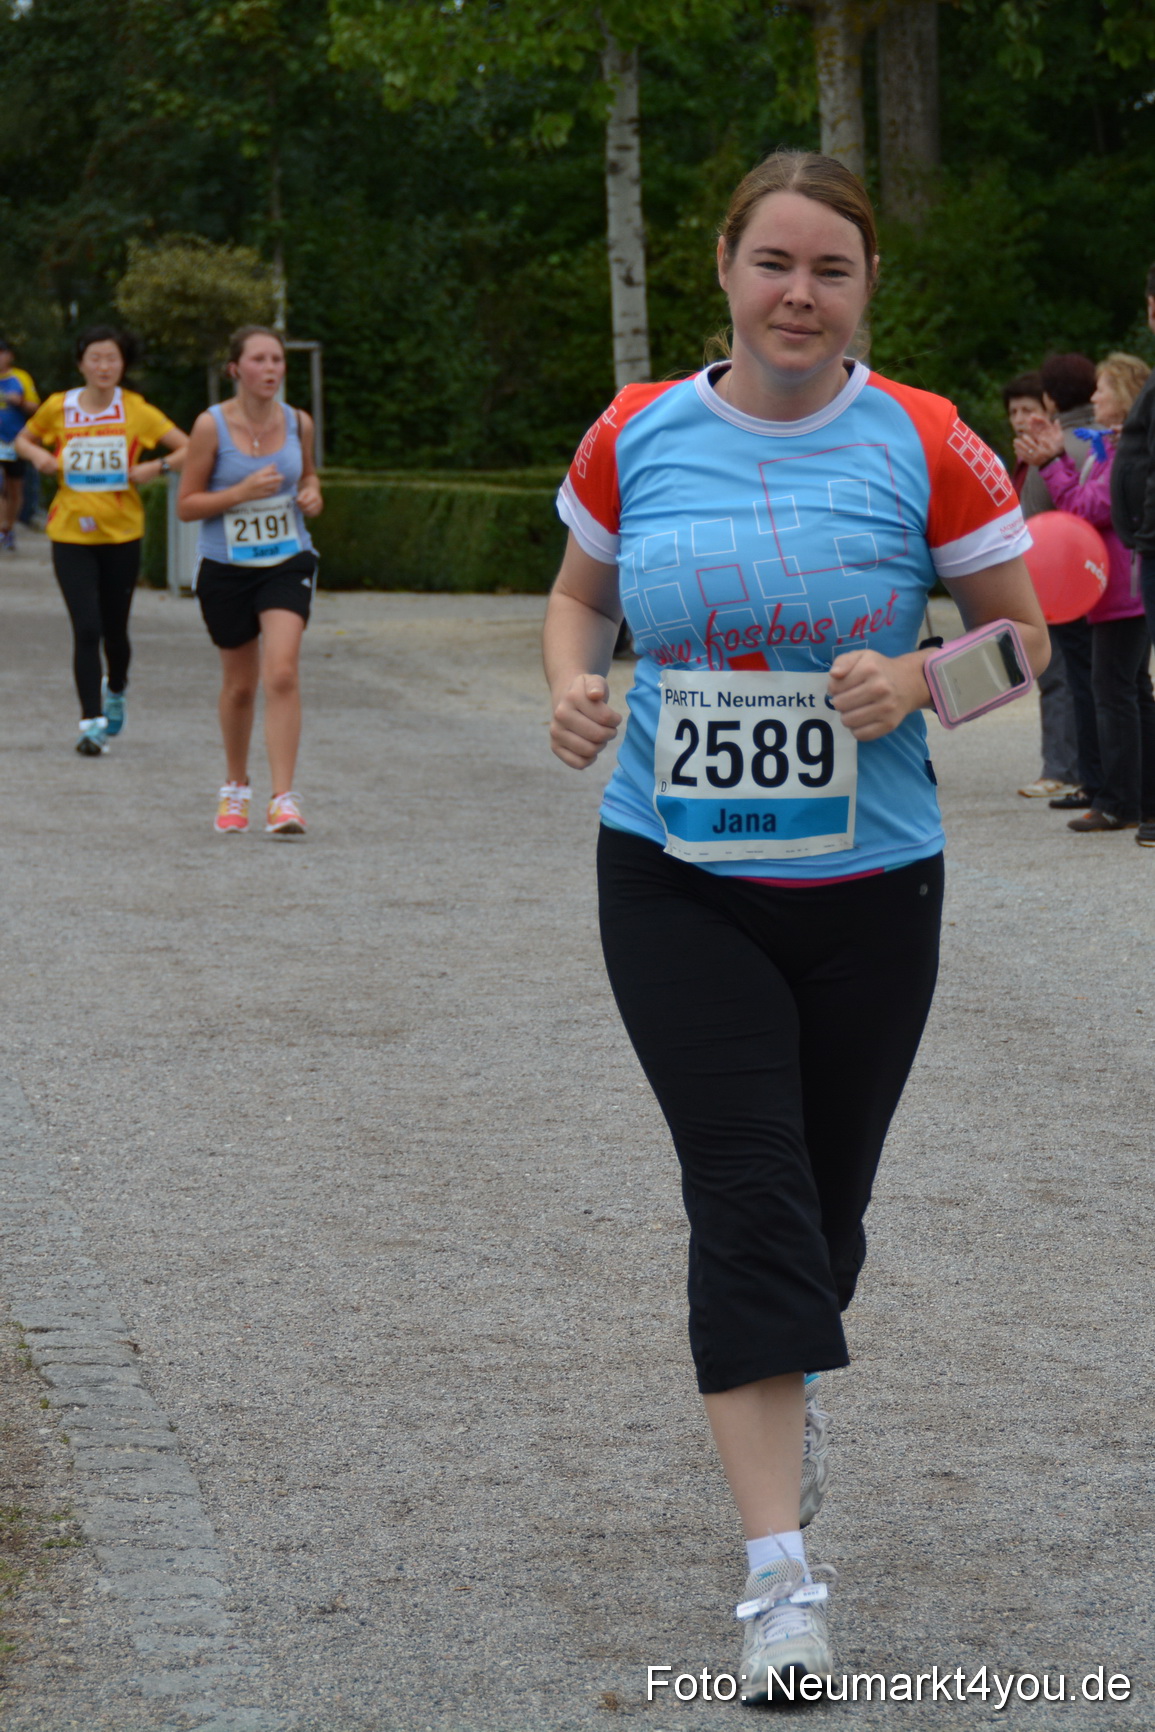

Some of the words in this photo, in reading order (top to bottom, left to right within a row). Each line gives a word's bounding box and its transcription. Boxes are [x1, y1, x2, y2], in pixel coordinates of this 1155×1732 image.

[70, 450, 122, 471] 2715
[234, 513, 289, 542] 2191
[665, 688, 711, 708] PARTL
[717, 691, 816, 708] Neumarkt
[671, 718, 835, 789] 2589
[712, 808, 777, 834] Jana
